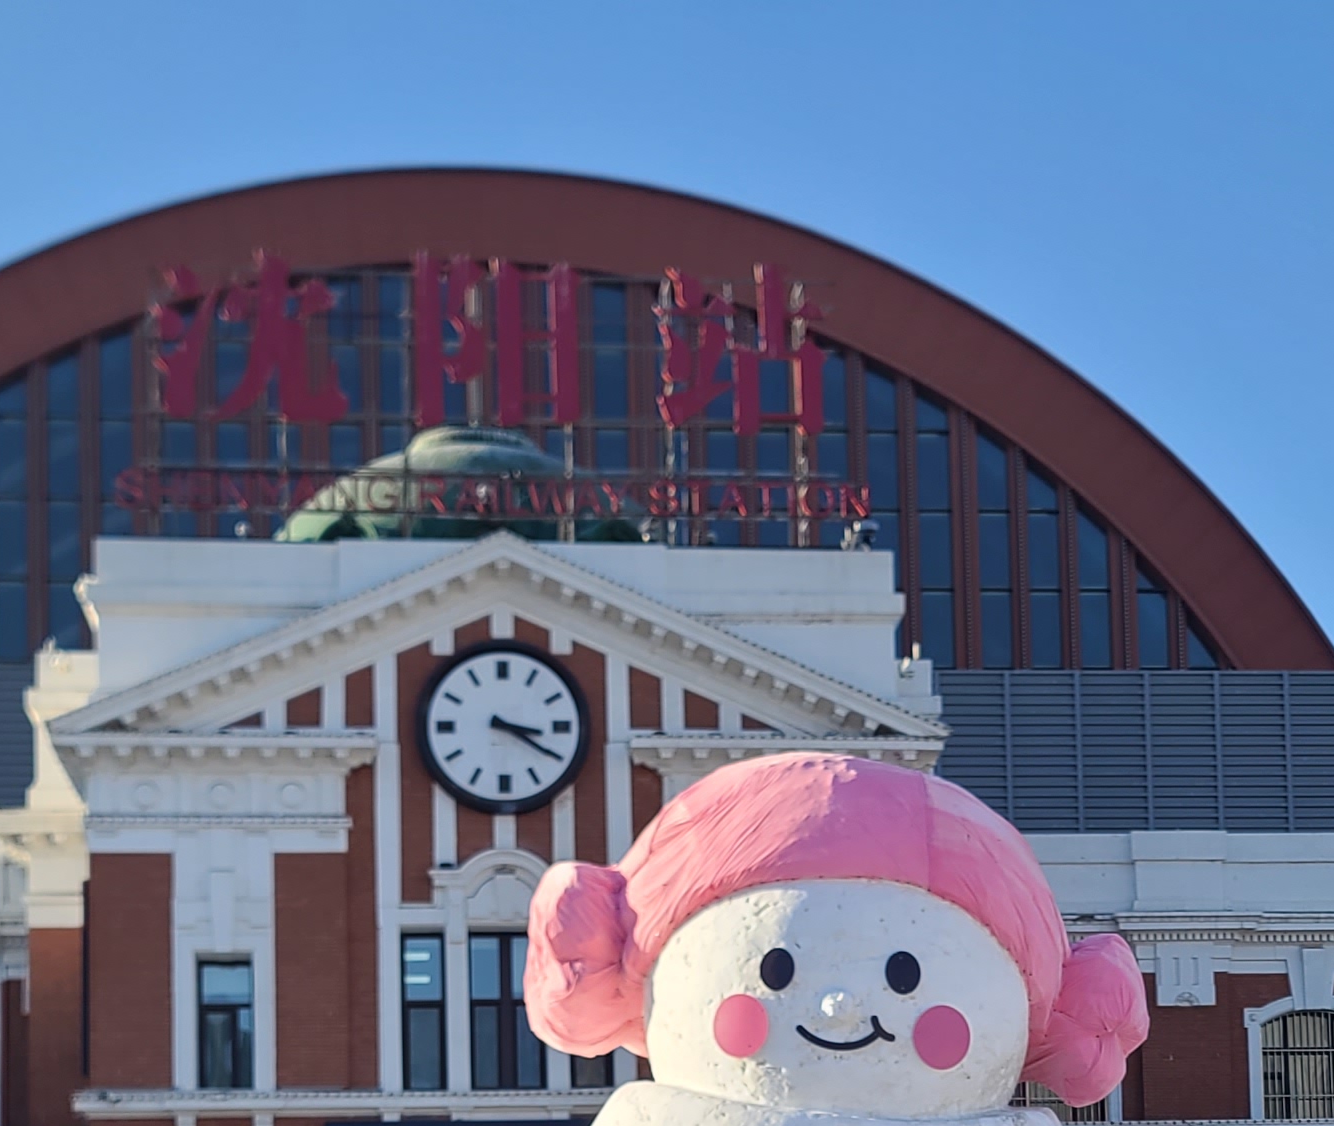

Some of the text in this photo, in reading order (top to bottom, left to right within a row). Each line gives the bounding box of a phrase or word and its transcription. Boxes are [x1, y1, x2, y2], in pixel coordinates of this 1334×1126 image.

[150, 248, 828, 436] 沈阳站
[115, 467, 871, 518] SHENYANG RAILWAY STATION
